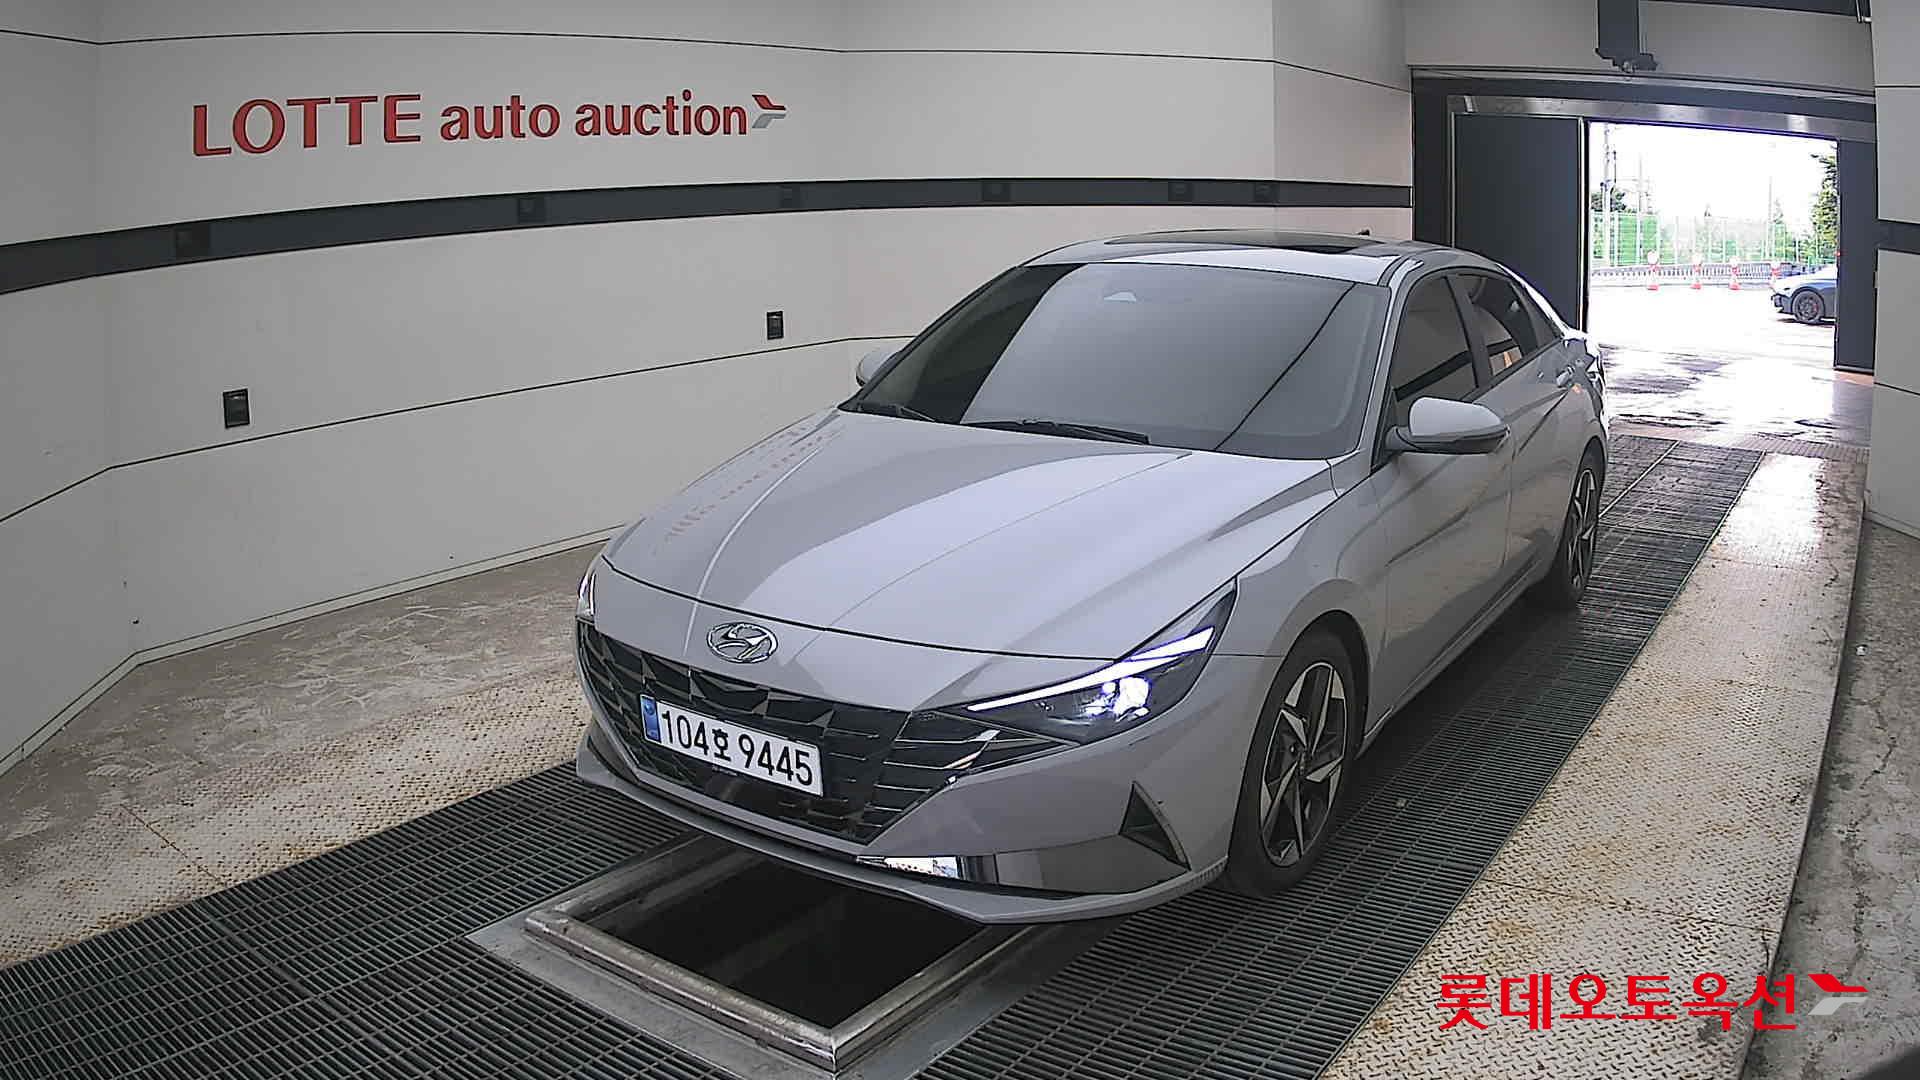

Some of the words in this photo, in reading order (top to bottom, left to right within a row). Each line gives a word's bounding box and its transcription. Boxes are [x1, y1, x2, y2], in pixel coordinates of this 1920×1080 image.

[193, 94, 422, 157] LOTTE
[440, 95, 560, 141] auto
[574, 89, 749, 136] auction
[661, 710, 731, 762] 104호
[738, 733, 813, 786] 9445
